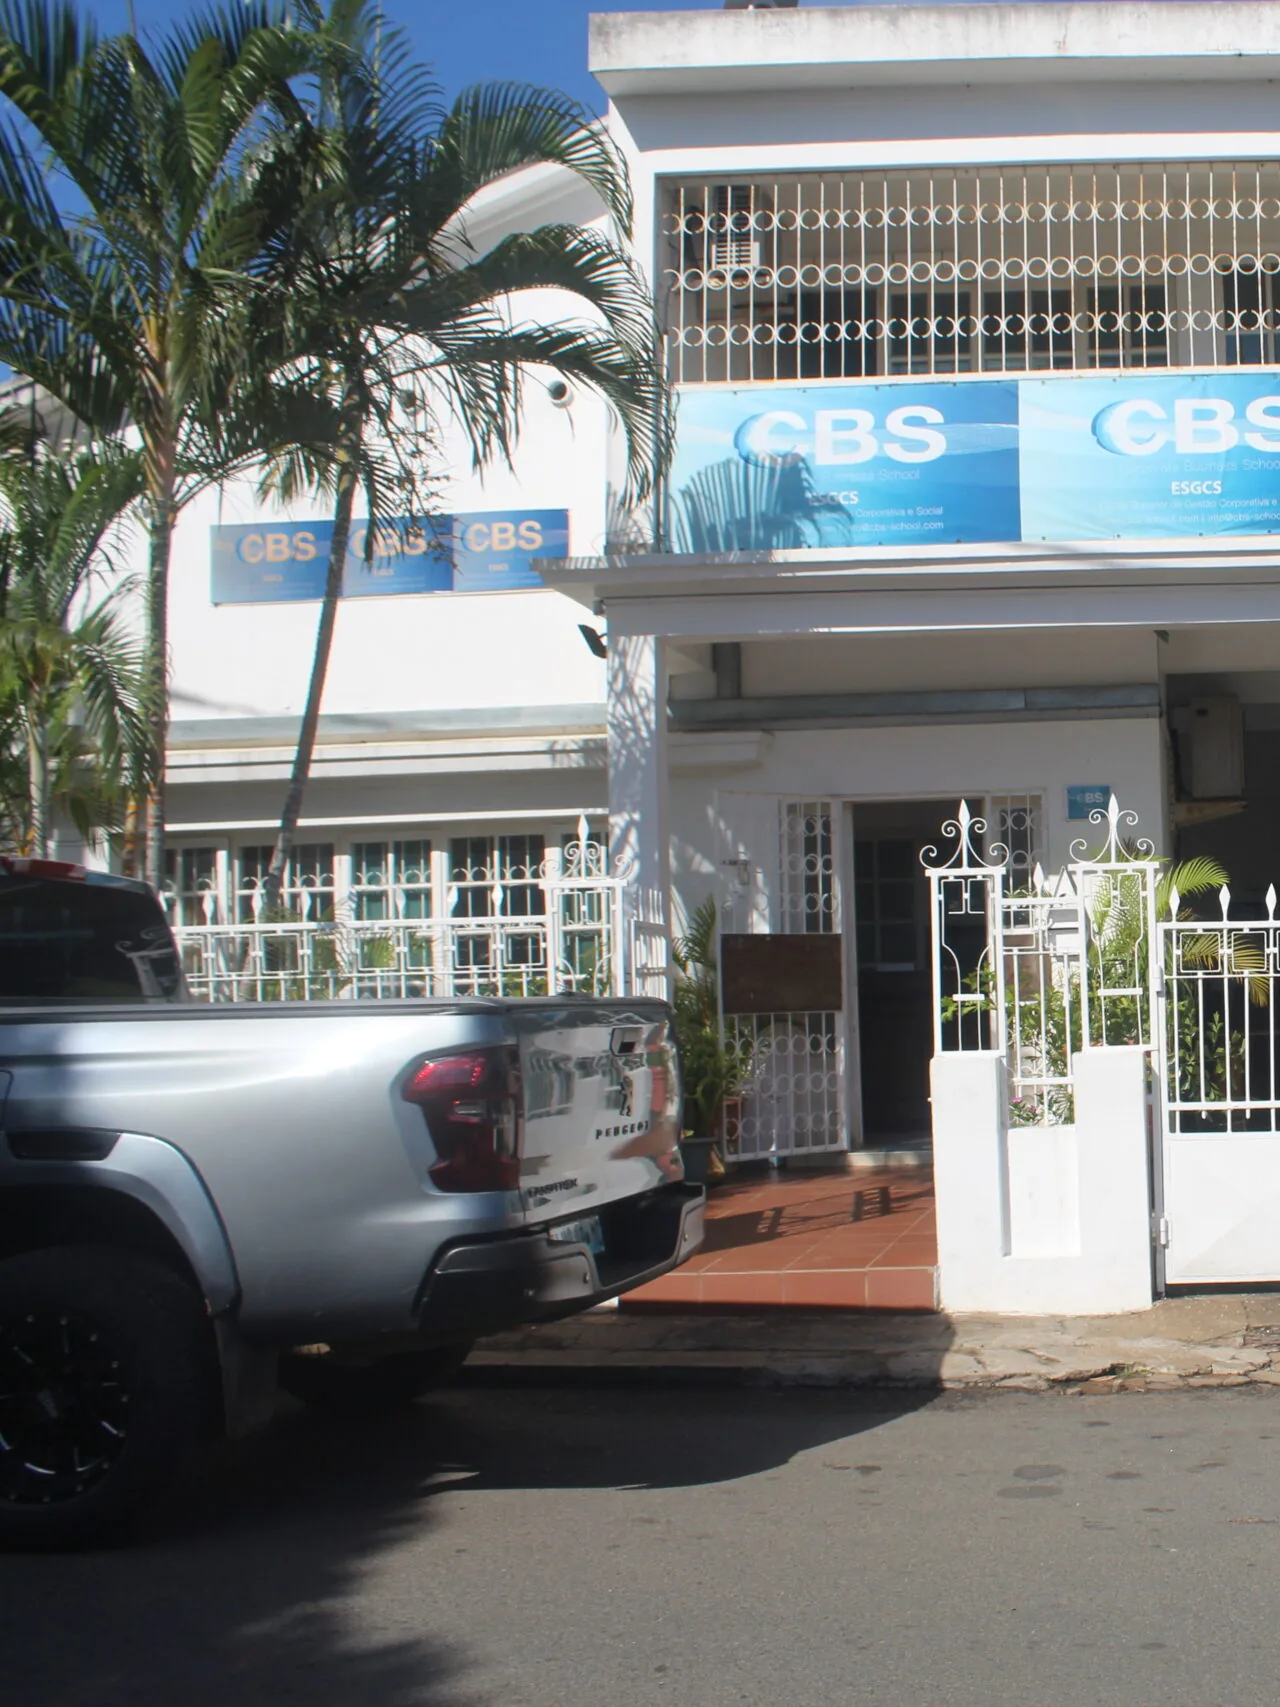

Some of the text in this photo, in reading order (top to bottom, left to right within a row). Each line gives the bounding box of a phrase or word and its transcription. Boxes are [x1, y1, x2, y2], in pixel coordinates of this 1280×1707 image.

[749, 405, 948, 468] CBS
[1171, 480, 1223, 496] ESGCS
[915, 505, 944, 516] Social
[1218, 497, 1270, 509] Corporativa
[465, 520, 544, 552] CBS
[240, 531, 317, 564] CBS
[594, 1120, 649, 1140] PEUGEOT
